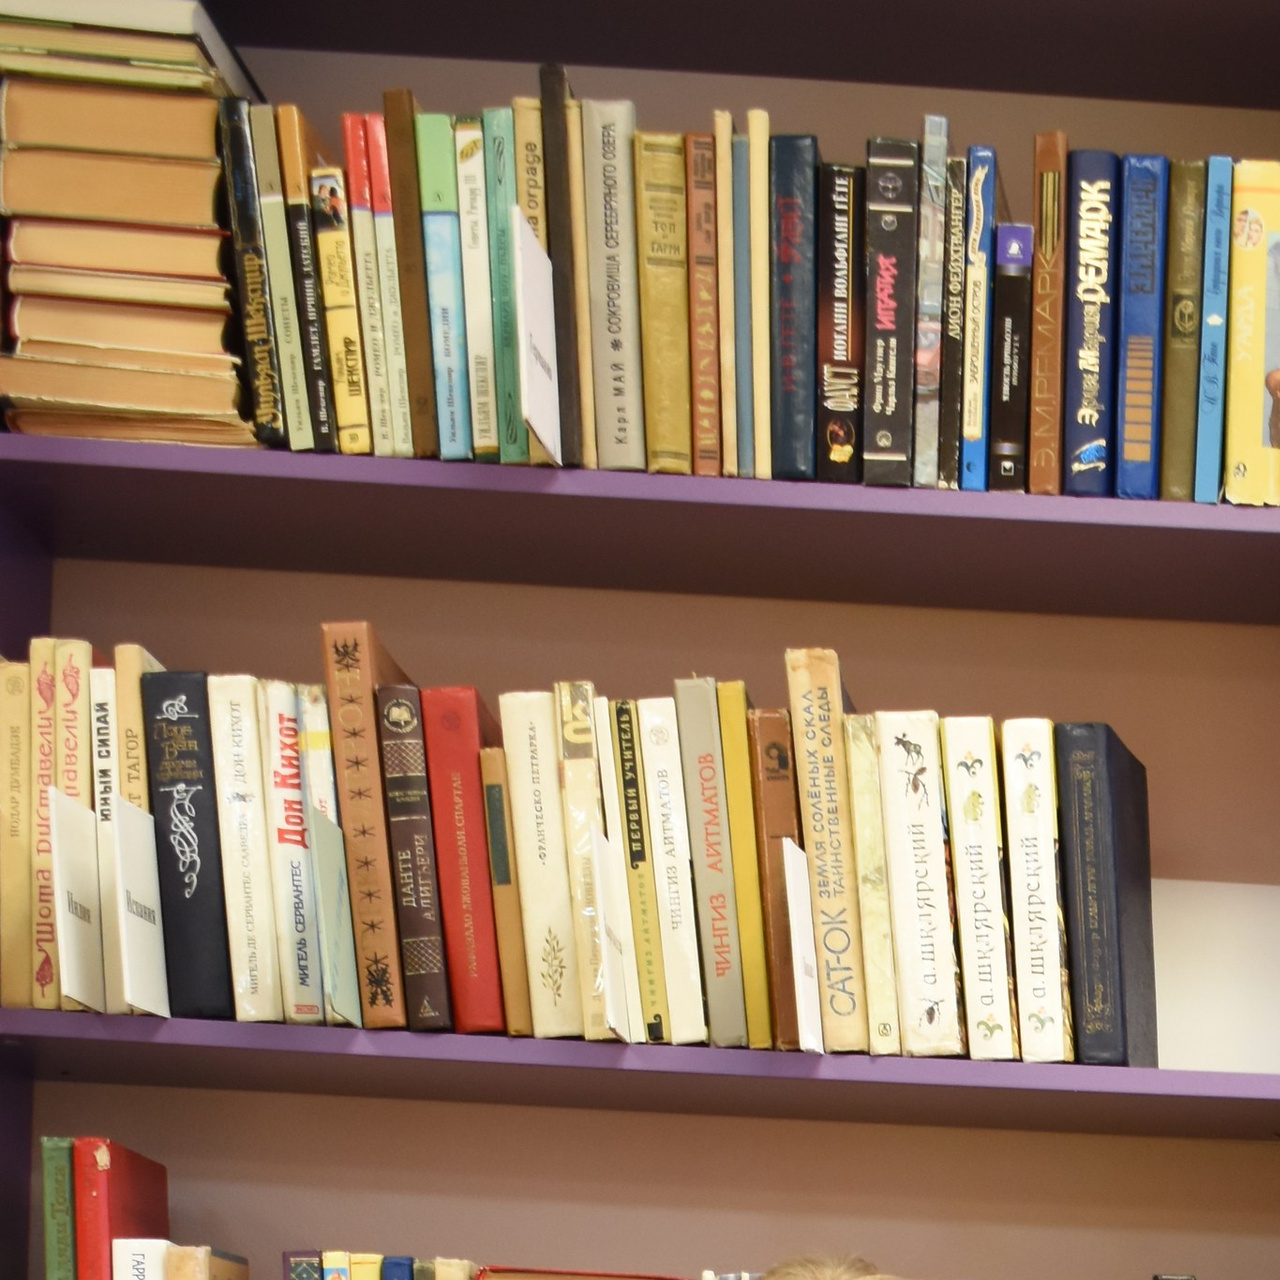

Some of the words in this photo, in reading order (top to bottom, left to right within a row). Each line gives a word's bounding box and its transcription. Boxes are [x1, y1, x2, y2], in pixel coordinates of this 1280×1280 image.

[601, 123, 615, 160] ОЗЕРА
[602, 165, 619, 249] СЕРЕБРЯНОГО
[832, 178, 849, 210] ГЁТЕ
[834, 215, 848, 298] ВОЛЬФГАНГ
[947, 189, 963, 293] ФЕЙХТВАНГЕР
[1076, 180, 1112, 303] РЕМАРК
[243, 254, 271, 341] Шекспир
[605, 255, 621, 334] СОКРОВИЩА
[949, 296, 962, 339] ЛИОН
[832, 302, 848, 361] ИОГАНН
[254, 344, 279, 427] Уильям
[610, 363, 624, 396] МАЙ
[824, 364, 858, 411] ФАУСТ
[615, 407, 627, 444] Карл
[94, 702, 110, 758] СИПАЙ
[801, 690, 816, 740] СКАЛ
[817, 687, 832, 747] СЛЕДЫ
[273, 713, 301, 791] Кихот
[98, 768, 112, 821] ЮНЫЙ
[697, 754, 724, 873] АЙТМАТОВ
[806, 749, 825, 833] СОЛЁНЫХ
[277, 799, 310, 849] Дон
[822, 755, 845, 897] ТАИНСТВЕННЫЕ
[291, 861, 305, 933] СЕРВАНТЕС
[398, 850, 416, 907] ДАНТЕ
[415, 835, 435, 921] АЛИГЬЕРИ
[815, 841, 831, 899] ЗЕМЛЯ
[66, 889, 91, 926] Индия
[125, 890, 156, 926] Испания
[709, 894, 731, 978] ЧИНГИЗ
[966, 845, 994, 982] шклярский
[294, 938, 309, 987] МИГЕЛЬ
[821, 908, 856, 1016] САТ-ОК
